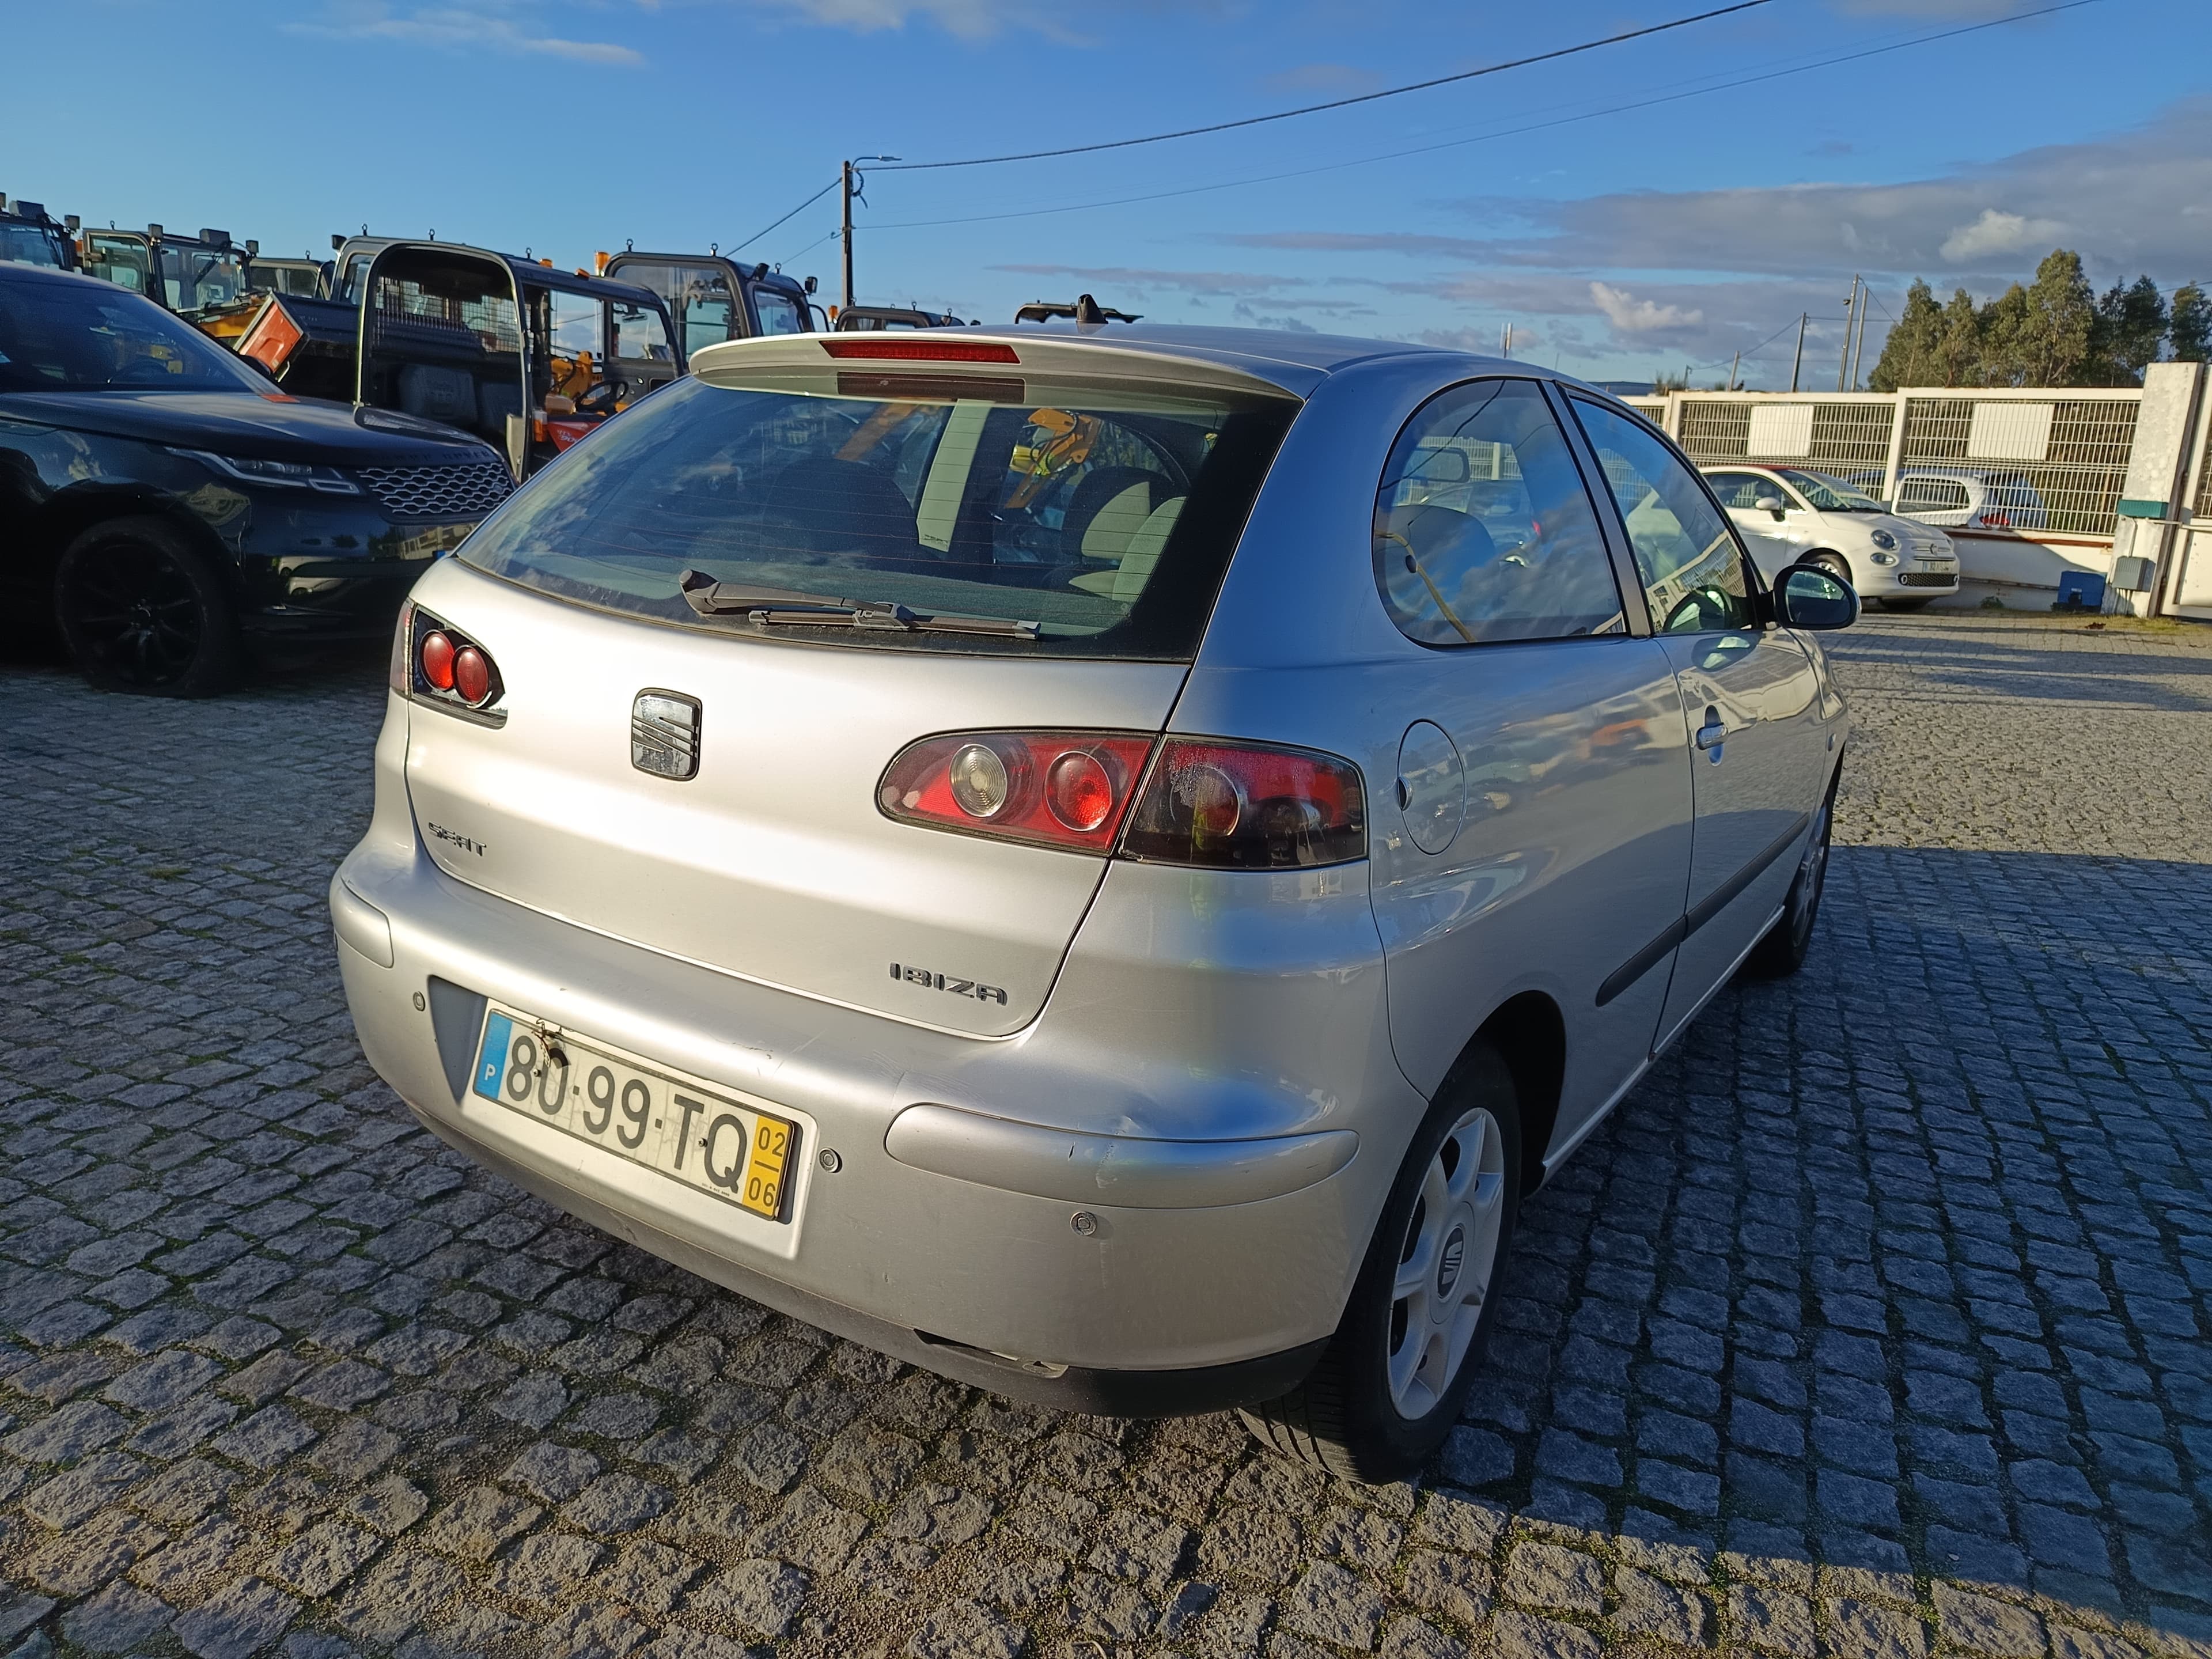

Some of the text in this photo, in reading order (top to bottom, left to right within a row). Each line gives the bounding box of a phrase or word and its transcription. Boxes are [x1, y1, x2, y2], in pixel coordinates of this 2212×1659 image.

[428, 821, 487, 857] SEAT
[889, 961, 1008, 1006] IBIZA
[484, 1063, 496, 1081] P
[758, 1127, 786, 1157] 02
[748, 1177, 775, 1207] 06
